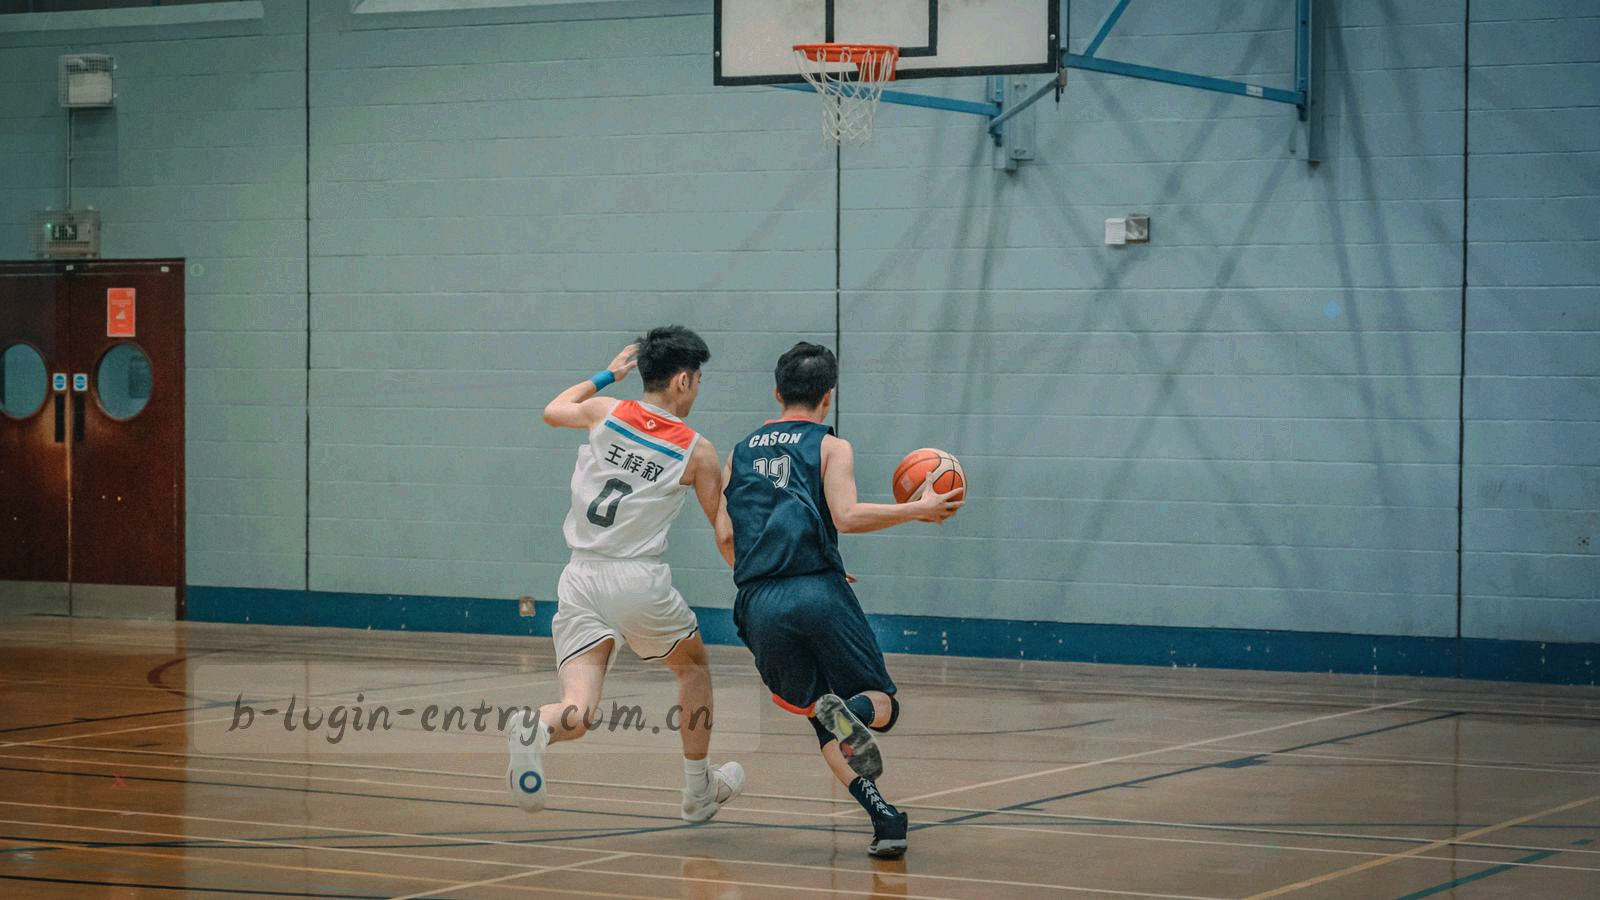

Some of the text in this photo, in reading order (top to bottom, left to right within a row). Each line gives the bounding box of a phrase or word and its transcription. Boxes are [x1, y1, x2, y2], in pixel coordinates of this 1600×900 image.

[748, 431, 802, 448] CASON
[604, 443, 665, 483] 王梓叙
[586, 478, 633, 528] 0
